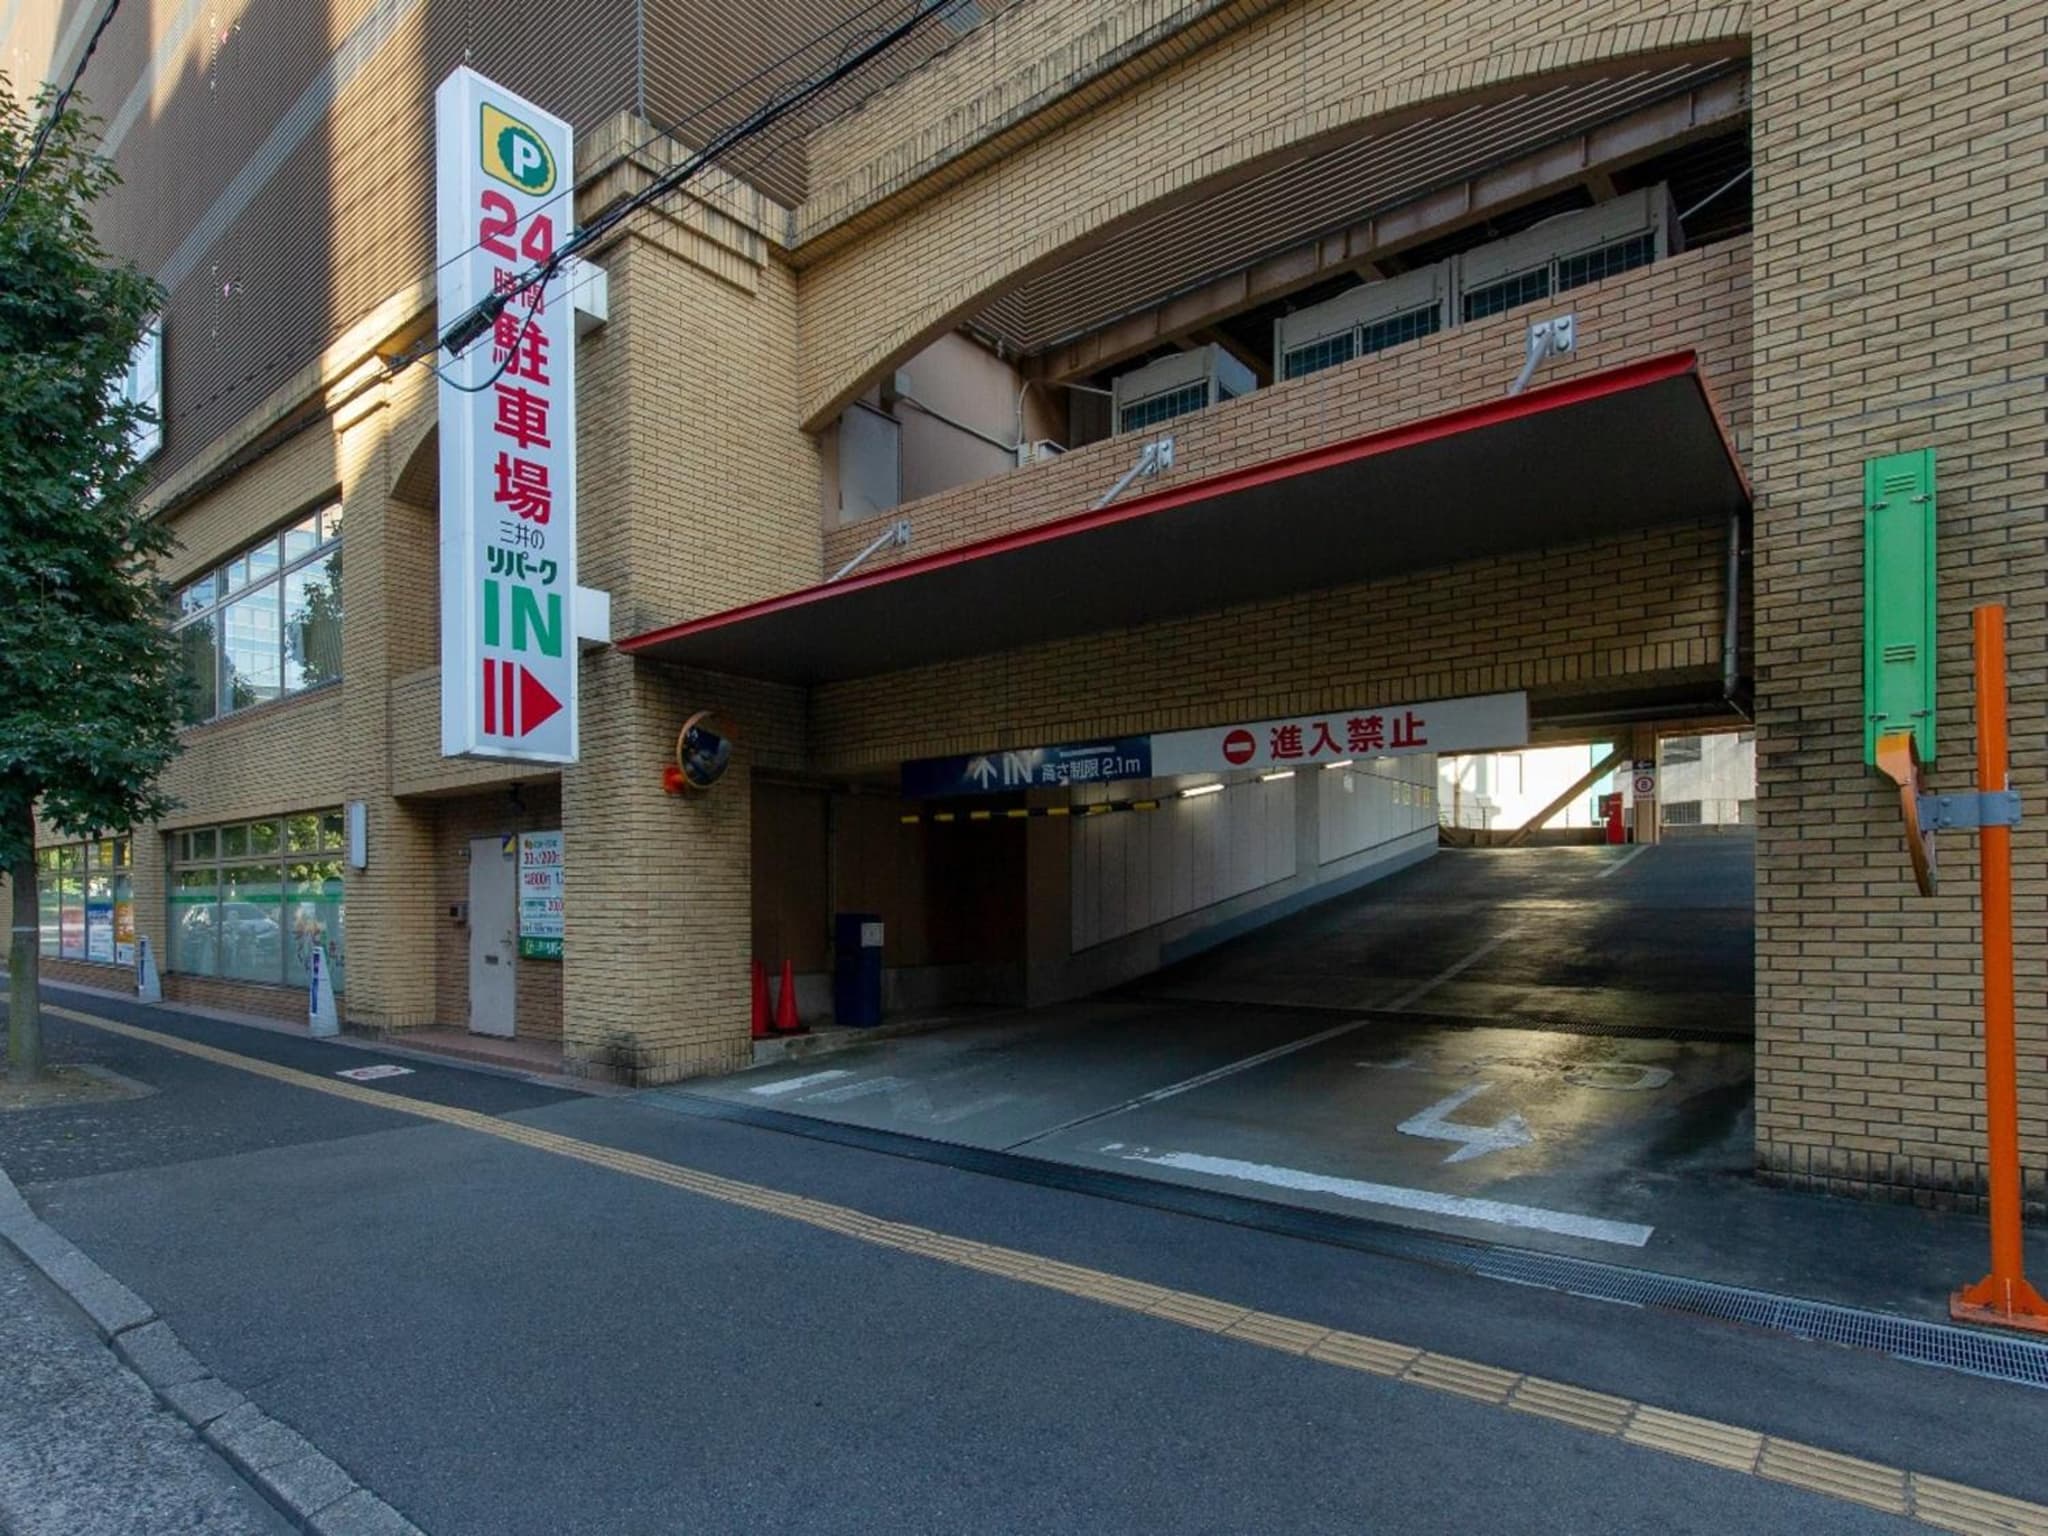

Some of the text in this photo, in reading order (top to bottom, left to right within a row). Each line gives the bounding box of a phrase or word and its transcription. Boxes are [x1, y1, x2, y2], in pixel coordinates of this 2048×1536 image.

[513, 133, 542, 178] P
[480, 190, 553, 265] 24
[493, 312, 552, 525] 駐車場
[500, 521, 545, 549] 三井の
[487, 545, 557, 584] リパーク
[484, 579, 561, 658] IN
[1270, 711, 1427, 759] 進入禁止
[1003, 753, 1141, 785] IN 高さ制限 2.1m
